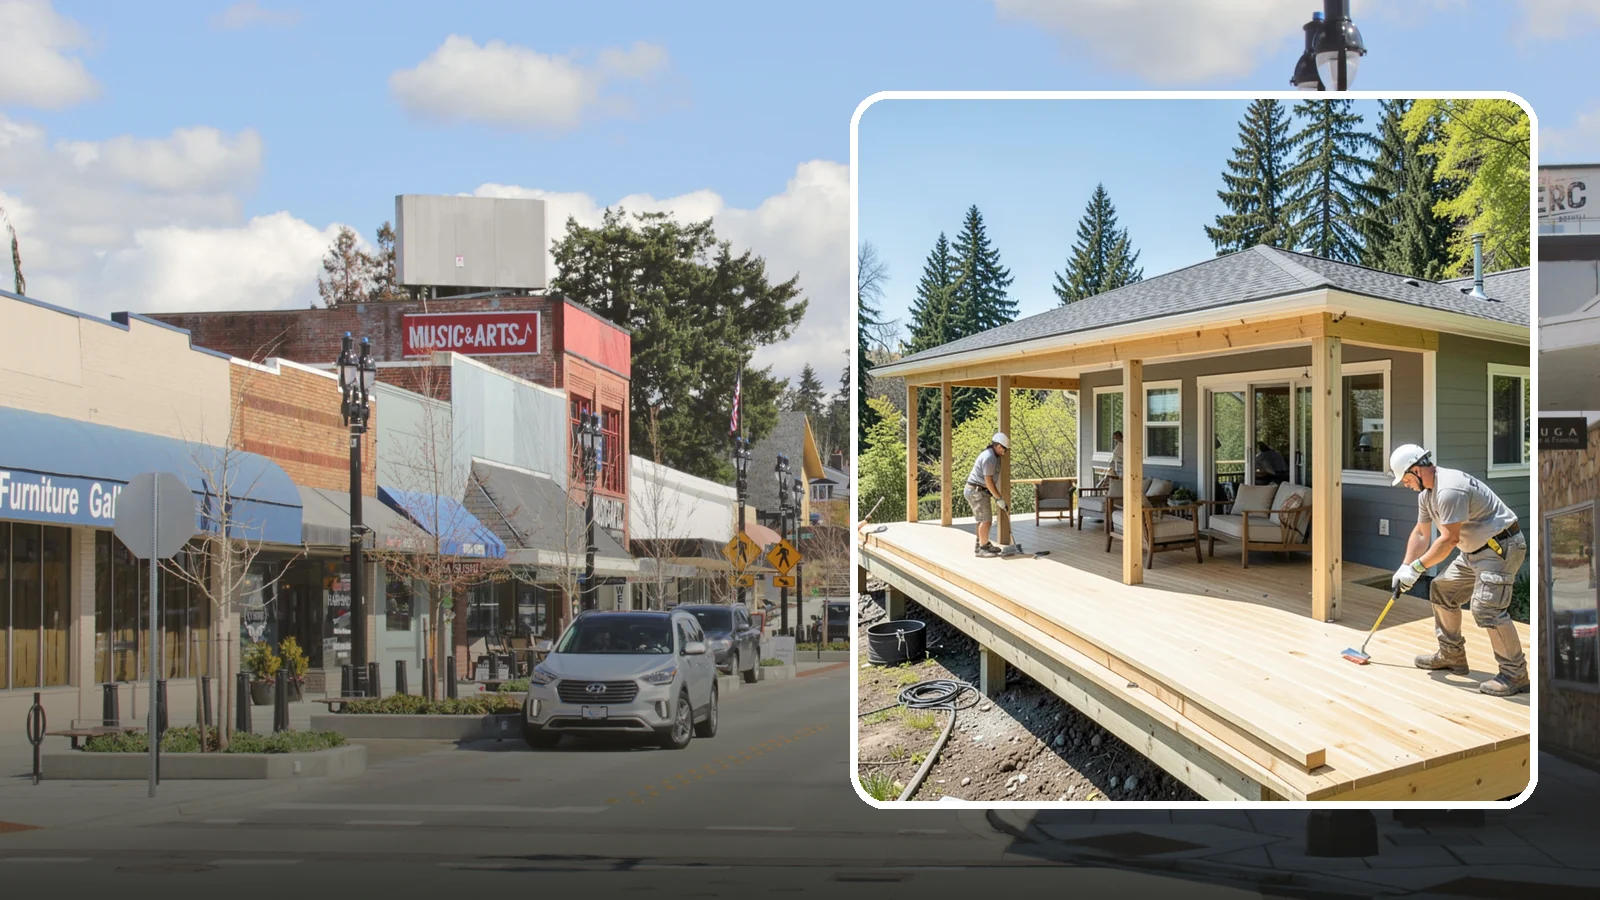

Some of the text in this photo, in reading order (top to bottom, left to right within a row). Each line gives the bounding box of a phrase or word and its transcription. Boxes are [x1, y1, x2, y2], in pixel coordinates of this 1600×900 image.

[408, 322, 520, 349] MUSIC&ARTS
[1540, 427, 1578, 437] UGA
[0, 471, 122, 519] Furniture Gal
